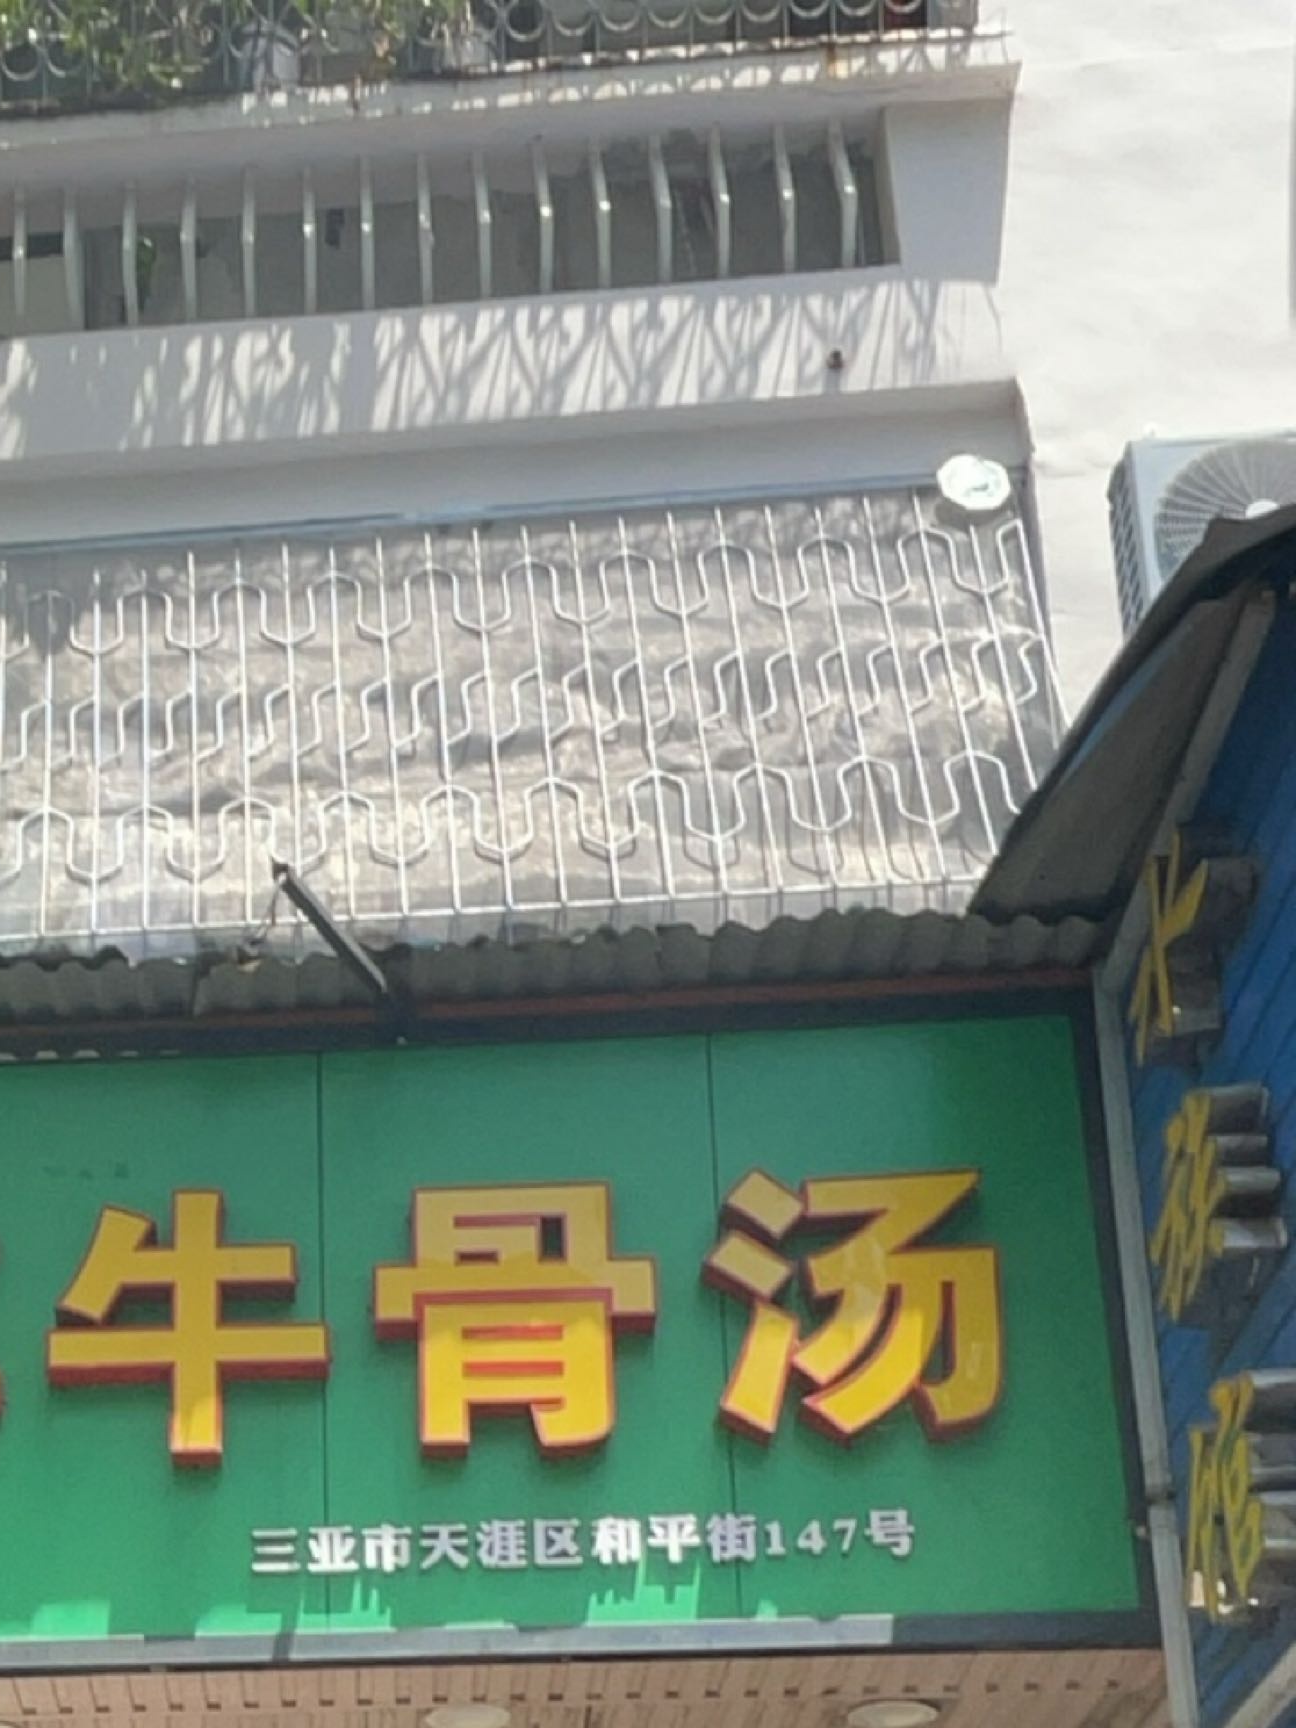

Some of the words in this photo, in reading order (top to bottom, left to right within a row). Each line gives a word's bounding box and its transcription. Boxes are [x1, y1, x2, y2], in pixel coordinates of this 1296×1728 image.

[250, 1508, 915, 1574] 三亚市天涯区和平街147号
